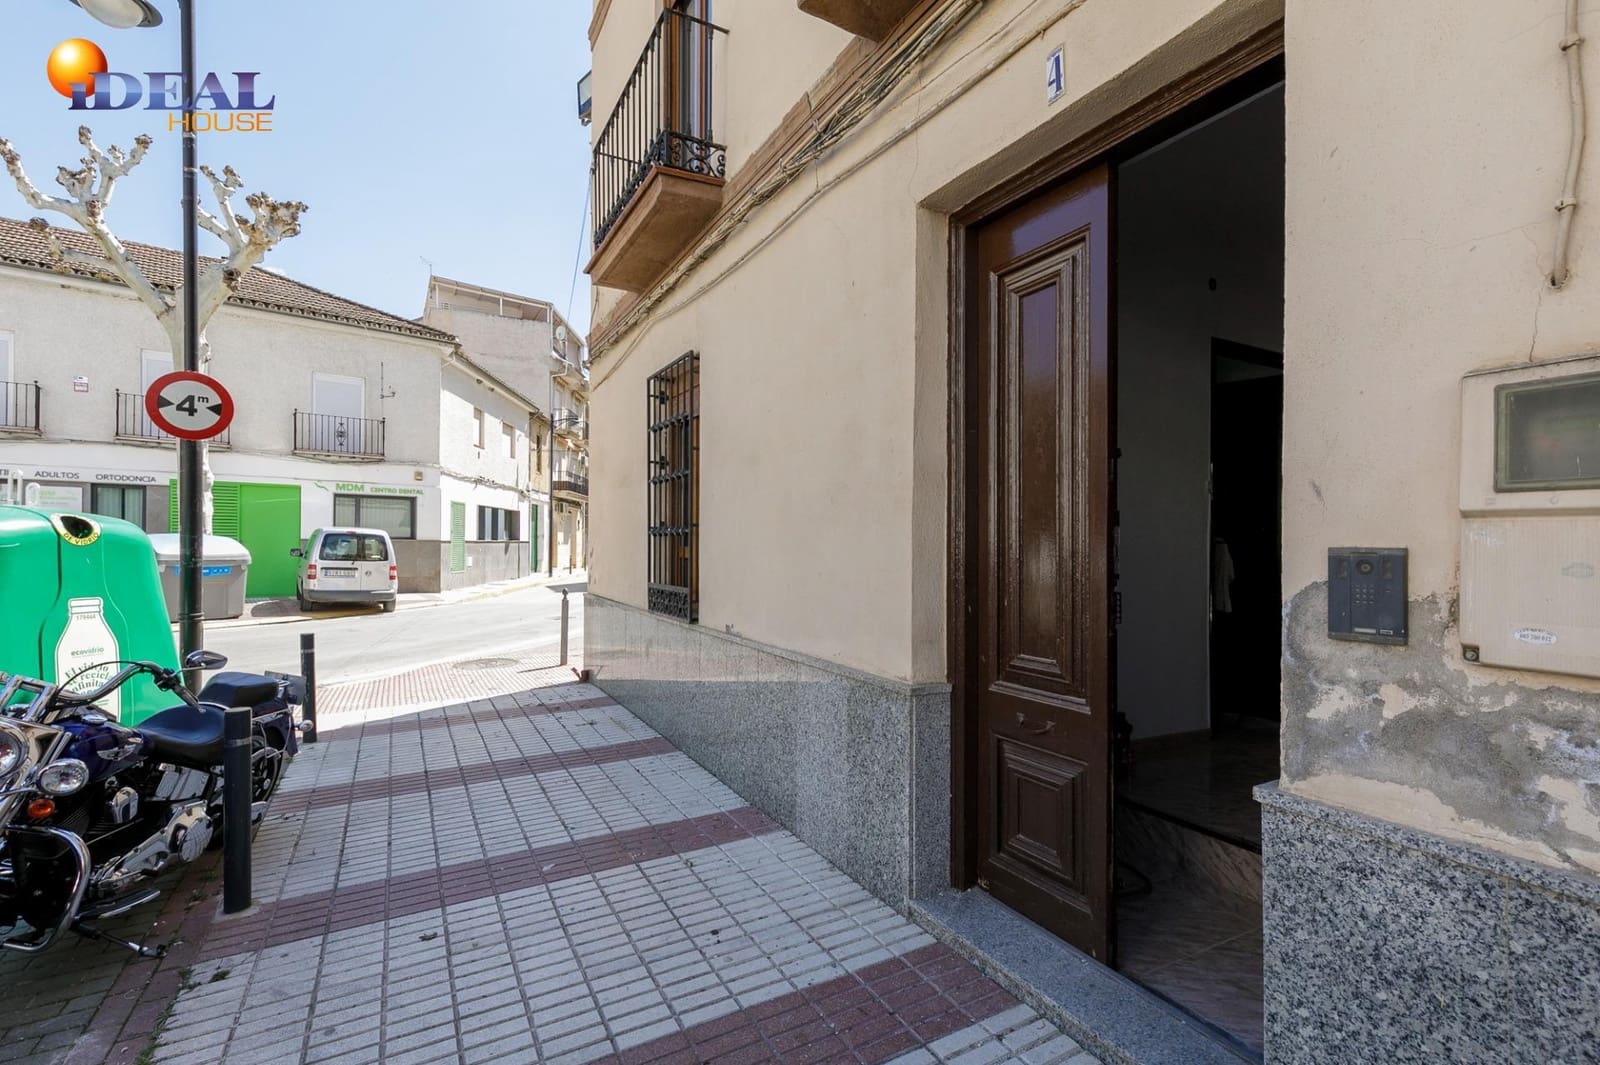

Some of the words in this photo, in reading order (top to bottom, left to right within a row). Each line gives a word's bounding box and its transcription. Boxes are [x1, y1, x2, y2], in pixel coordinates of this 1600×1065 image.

[1048, 55, 1062, 93] 4
[34, 470, 80, 479] ADULTOS
[95, 473, 157, 483] ORTODONCIA
[336, 483, 365, 492] MDM
[370, 486, 398, 494] CENTRO
[71, 647, 105, 656] ecovidrio
